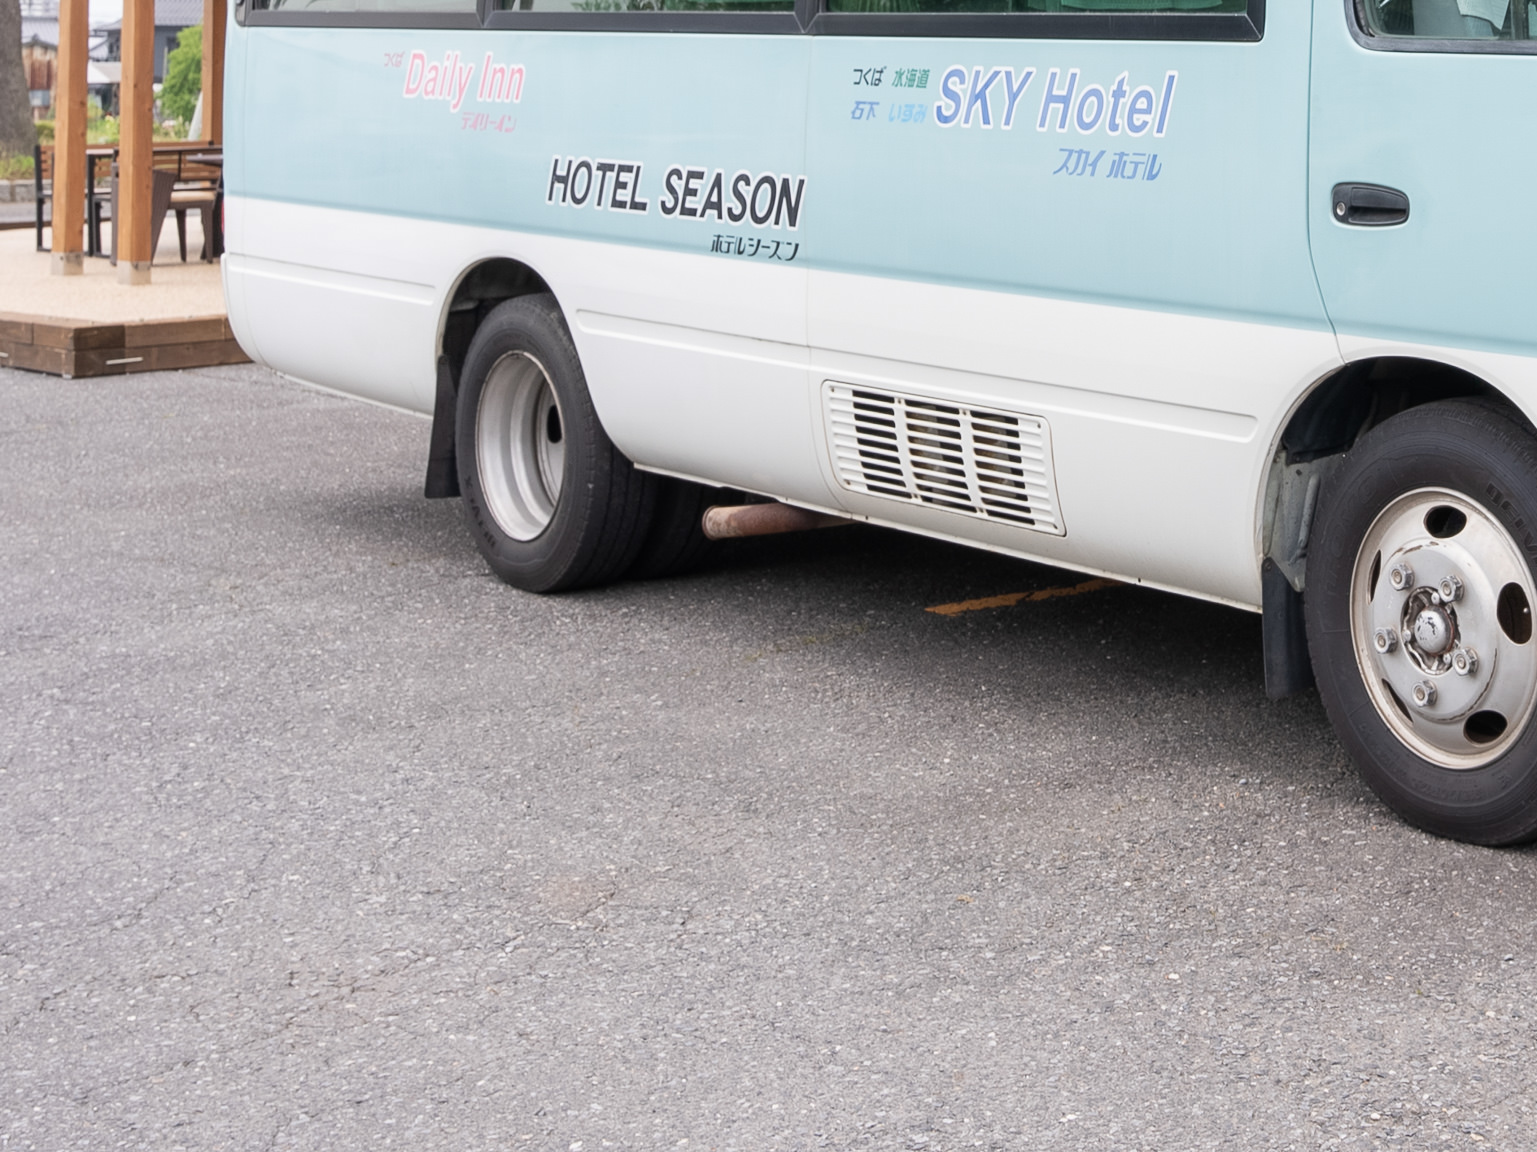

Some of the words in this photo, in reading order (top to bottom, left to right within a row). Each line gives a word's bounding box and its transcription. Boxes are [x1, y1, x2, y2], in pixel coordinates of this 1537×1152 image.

[404, 51, 474, 111] Daily
[478, 53, 525, 102] Inn
[853, 66, 887, 86] つくば
[892, 67, 930, 88] 水海道
[851, 100, 880, 121] 石下
[935, 66, 1035, 128] SKY
[1037, 69, 1177, 136] Hotel
[1053, 148, 1107, 177] スカイ
[1106, 152, 1163, 181] ホテル
[547, 158, 649, 212] HOTEL
[659, 167, 806, 228] SEASON
[710, 233, 800, 262] ホテルシーズン
